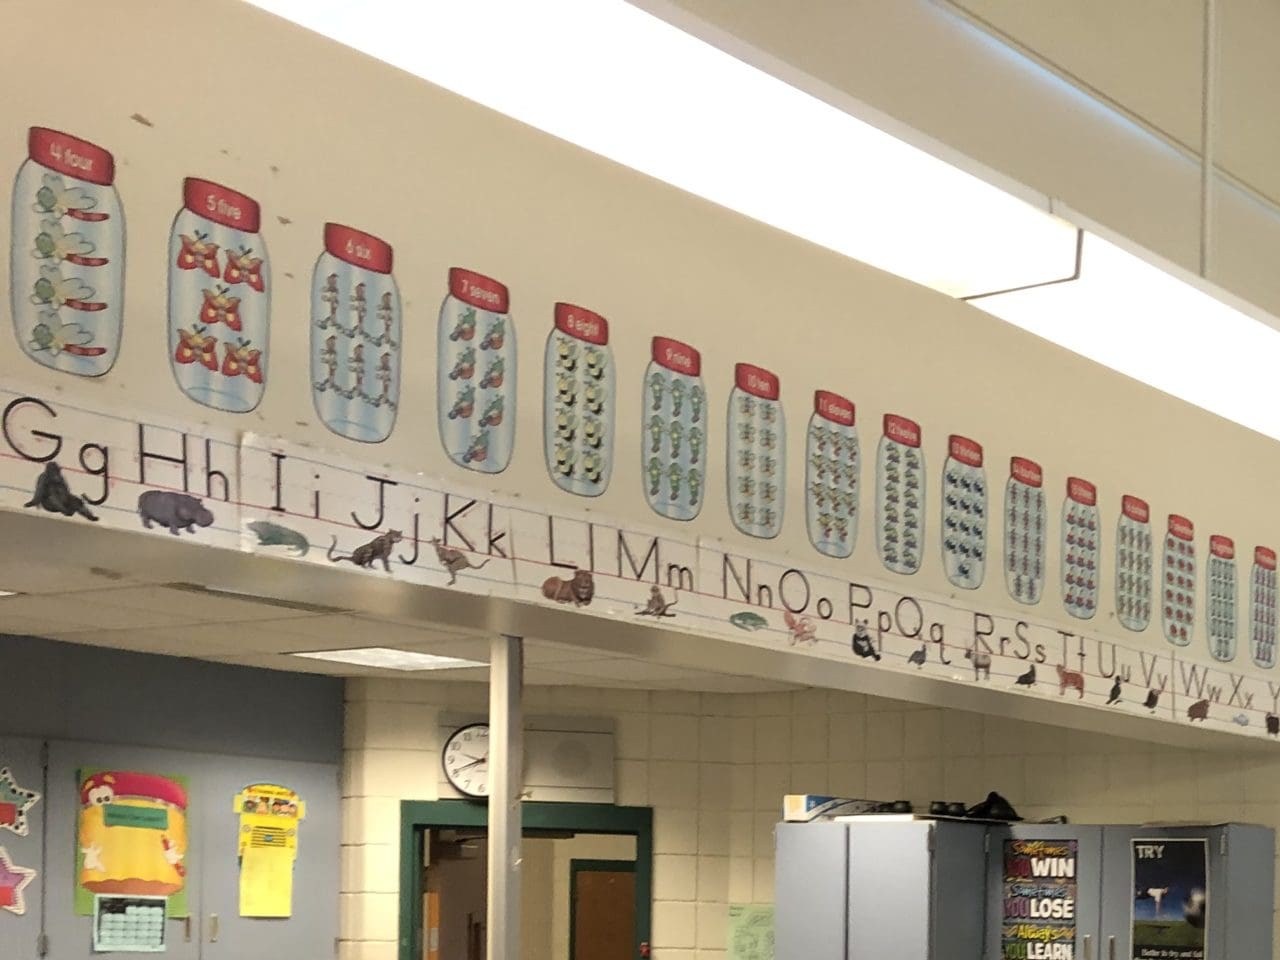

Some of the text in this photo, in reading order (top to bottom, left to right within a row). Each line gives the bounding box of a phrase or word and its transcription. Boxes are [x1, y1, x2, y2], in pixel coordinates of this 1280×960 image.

[50, 143, 94, 171] 4 four
[206, 194, 242, 220] 5 five
[345, 239, 353, 254] 6
[461, 279, 500, 304] 7 seven
[566, 314, 600, 338] 8 eight
[1136, 845, 1165, 859] TRY
[1030, 858, 1075, 878] WIN
[1004, 898, 1074, 918] YOU LOSE
[1027, 942, 1073, 960] LEARN
